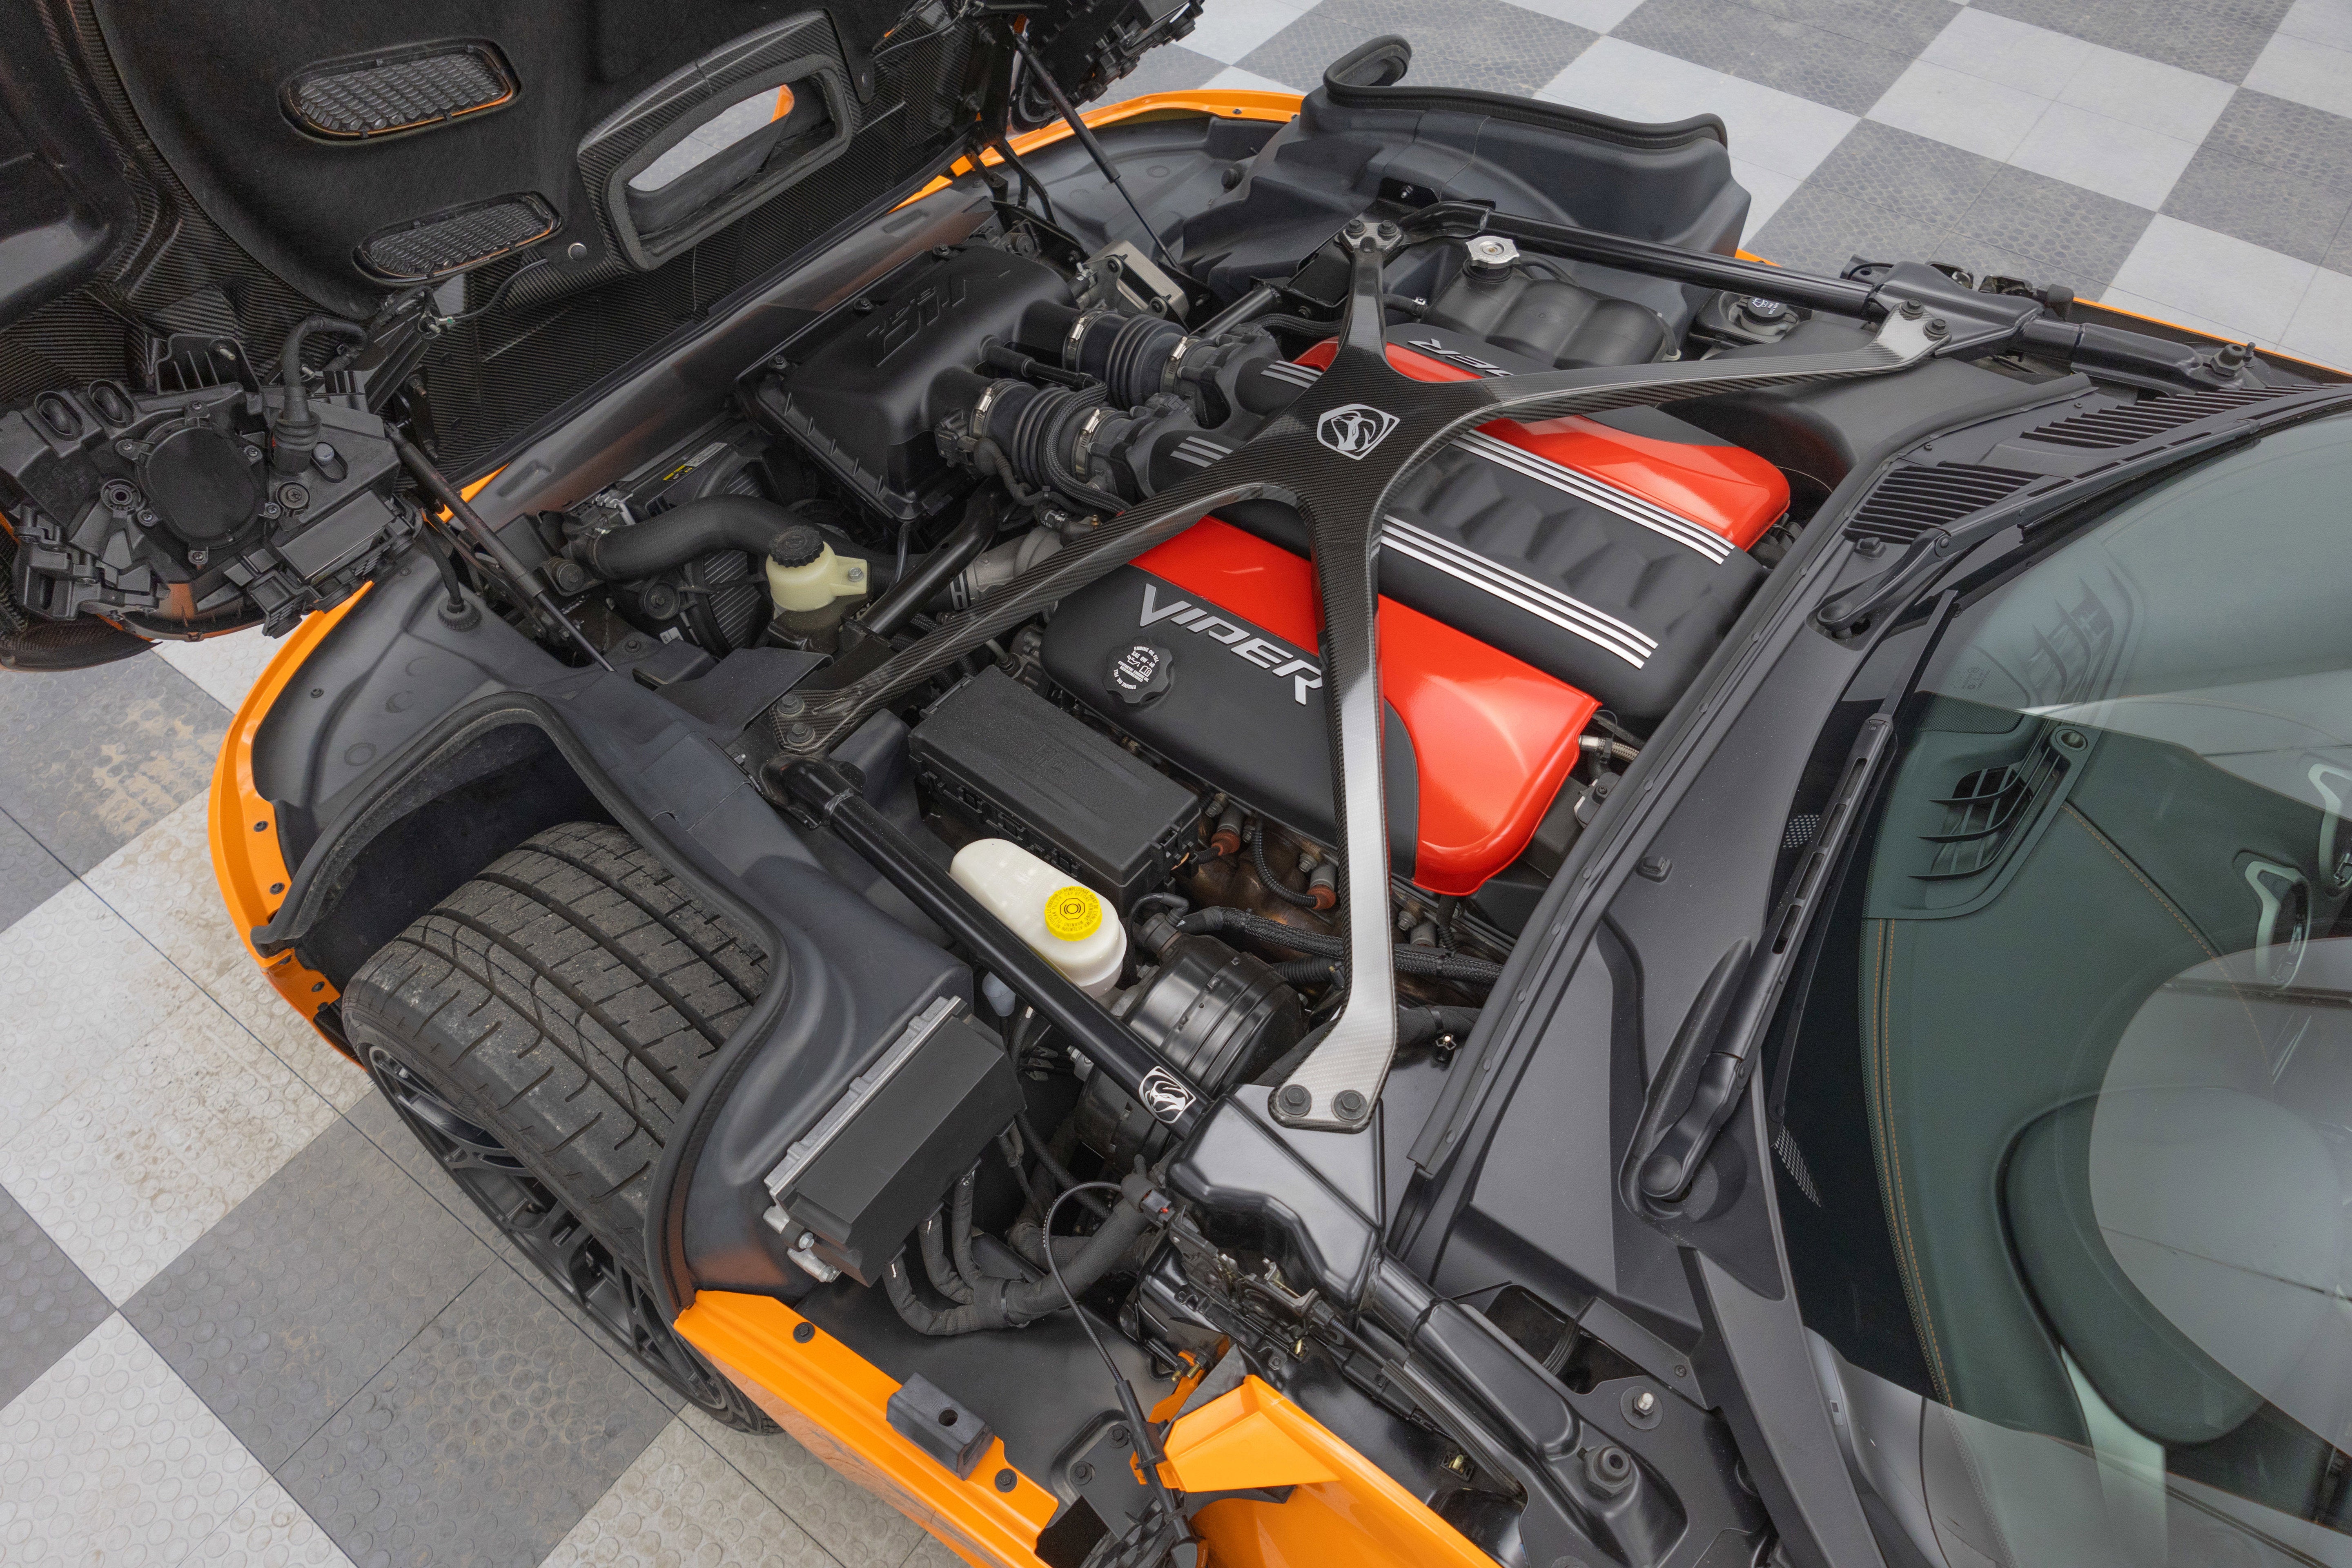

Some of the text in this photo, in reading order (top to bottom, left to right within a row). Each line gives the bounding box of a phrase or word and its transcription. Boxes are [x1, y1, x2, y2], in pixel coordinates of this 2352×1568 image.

[1140, 583, 1323, 705] VIPER
[1118, 660, 1134, 672] SYNTHETIC
[1134, 670, 1145, 679] ENGINE
[1119, 666, 1144, 682] RECOMMENDED
[1047, 893, 1059, 908] BOUCHON
[1089, 893, 1098, 904] AVANT
[1051, 896, 1062, 910] FILLER
[1075, 891, 1090, 902] BEFORE
[1052, 911, 1062, 924] CLEAN
[1084, 902, 1093, 922] REMOVING
